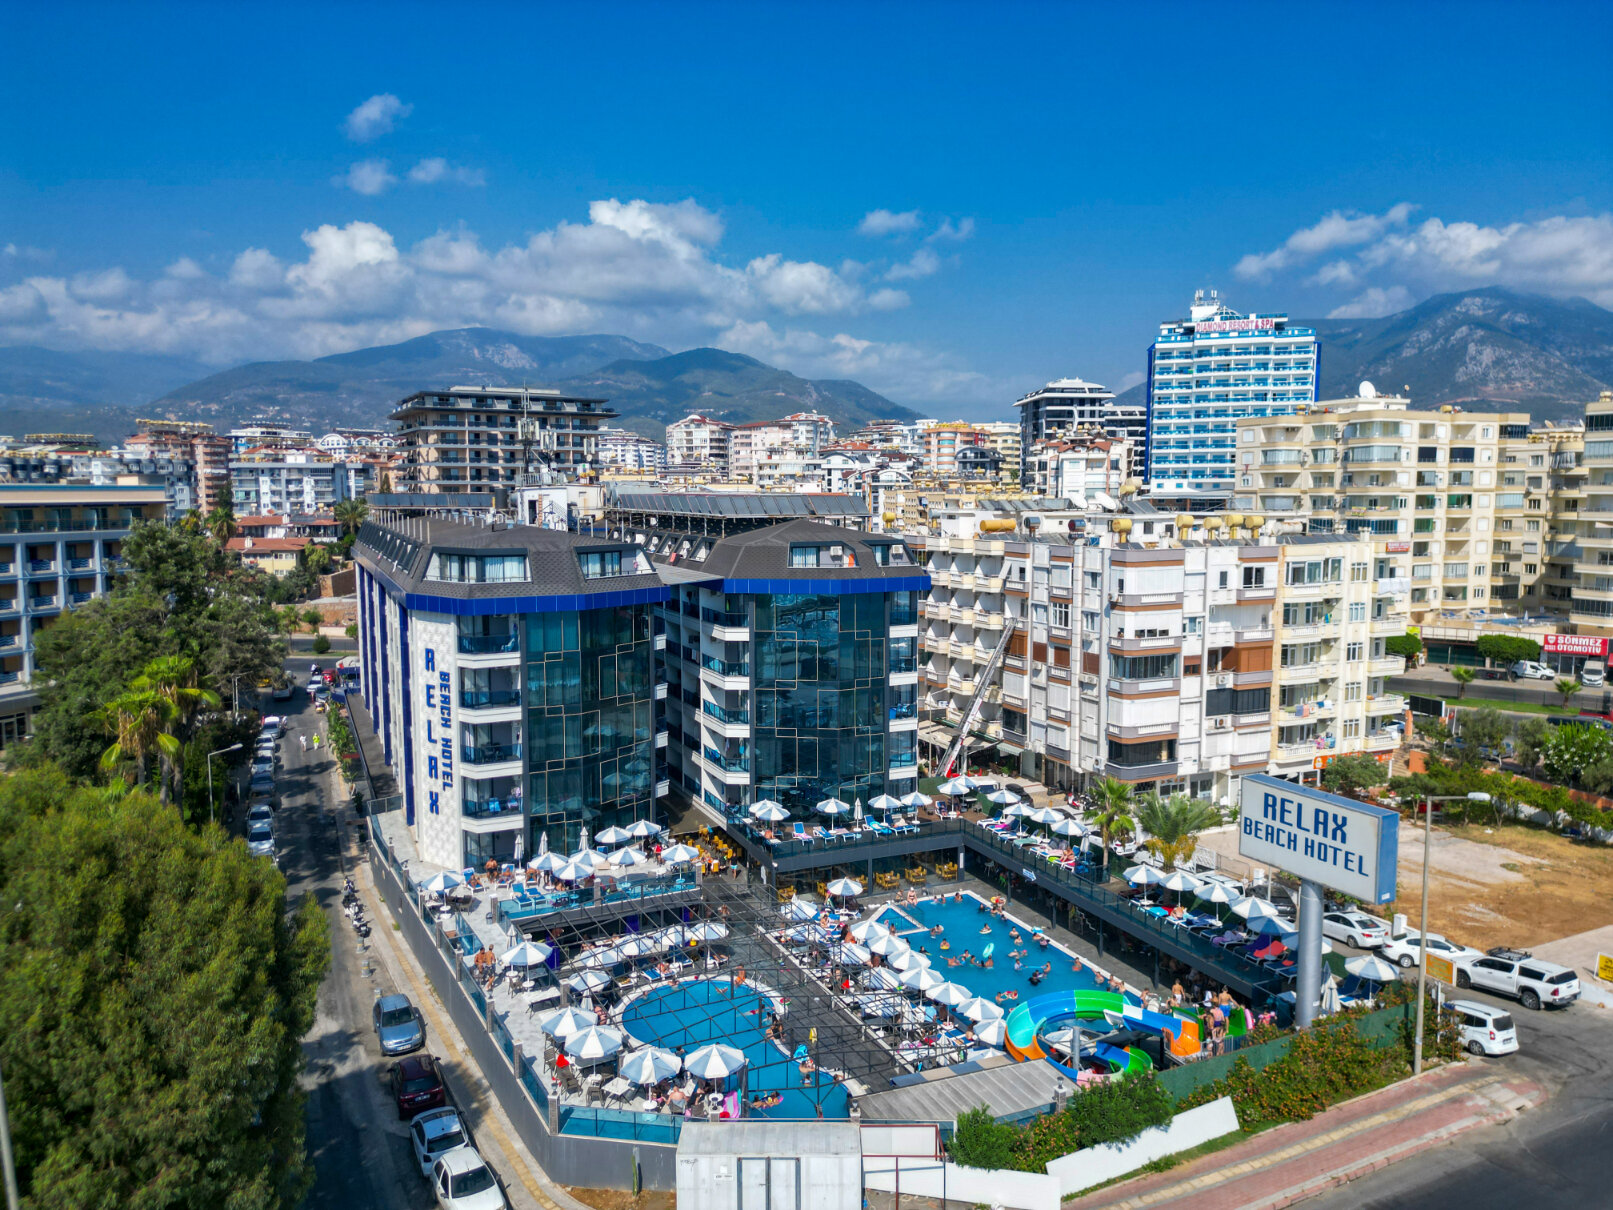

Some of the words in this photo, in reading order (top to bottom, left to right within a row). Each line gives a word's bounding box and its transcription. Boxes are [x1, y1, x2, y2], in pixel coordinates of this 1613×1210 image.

[1196, 321, 1227, 332] DIAMOND
[1228, 319, 1254, 331] RESORT
[1261, 318, 1274, 329] SPA
[439, 671, 452, 729] BEACH
[425, 648, 439, 815] RELAX
[441, 737, 453, 791] HOTEL
[1263, 792, 1348, 844] RELAX
[1243, 816, 1297, 852] BEACH
[1304, 837, 1369, 877] HOTEL
